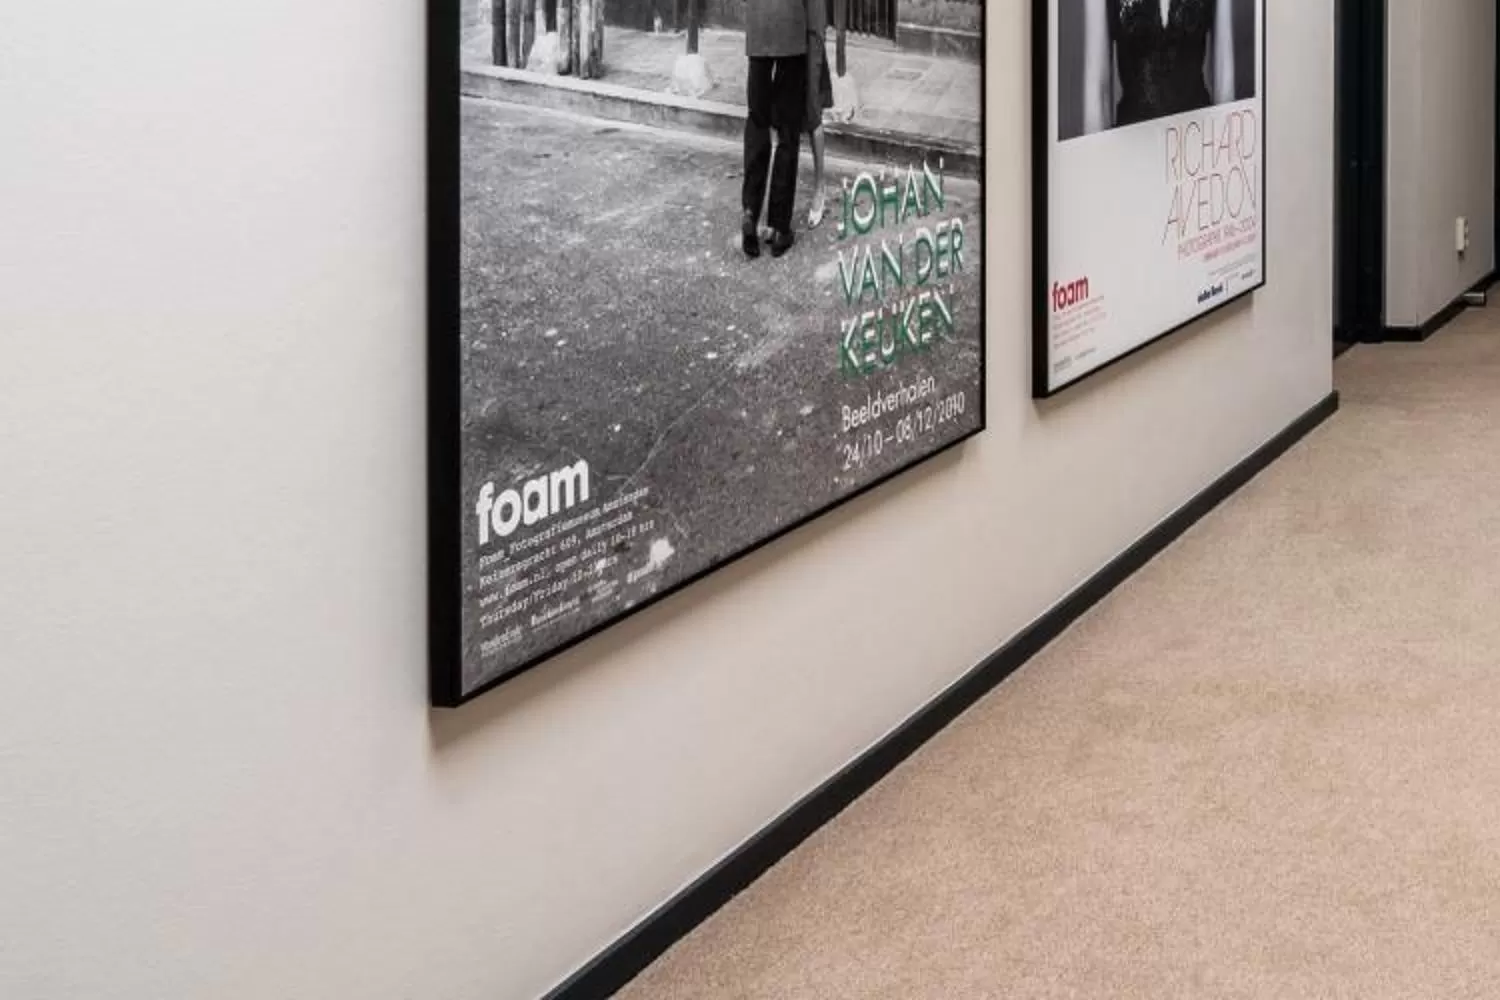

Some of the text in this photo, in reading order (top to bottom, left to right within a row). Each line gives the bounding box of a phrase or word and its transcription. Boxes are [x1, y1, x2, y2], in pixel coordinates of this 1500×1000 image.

[1166, 109, 1257, 184] RICHARD
[836, 156, 945, 241] JOHAN
[1161, 162, 1257, 246] AVEDON
[837, 217, 964, 306] VAN DER
[1052, 276, 1089, 312] foam
[838, 283, 955, 379] KEUKEN
[841, 375, 936, 433] Beeldverhalen
[476, 459, 589, 546] foam
